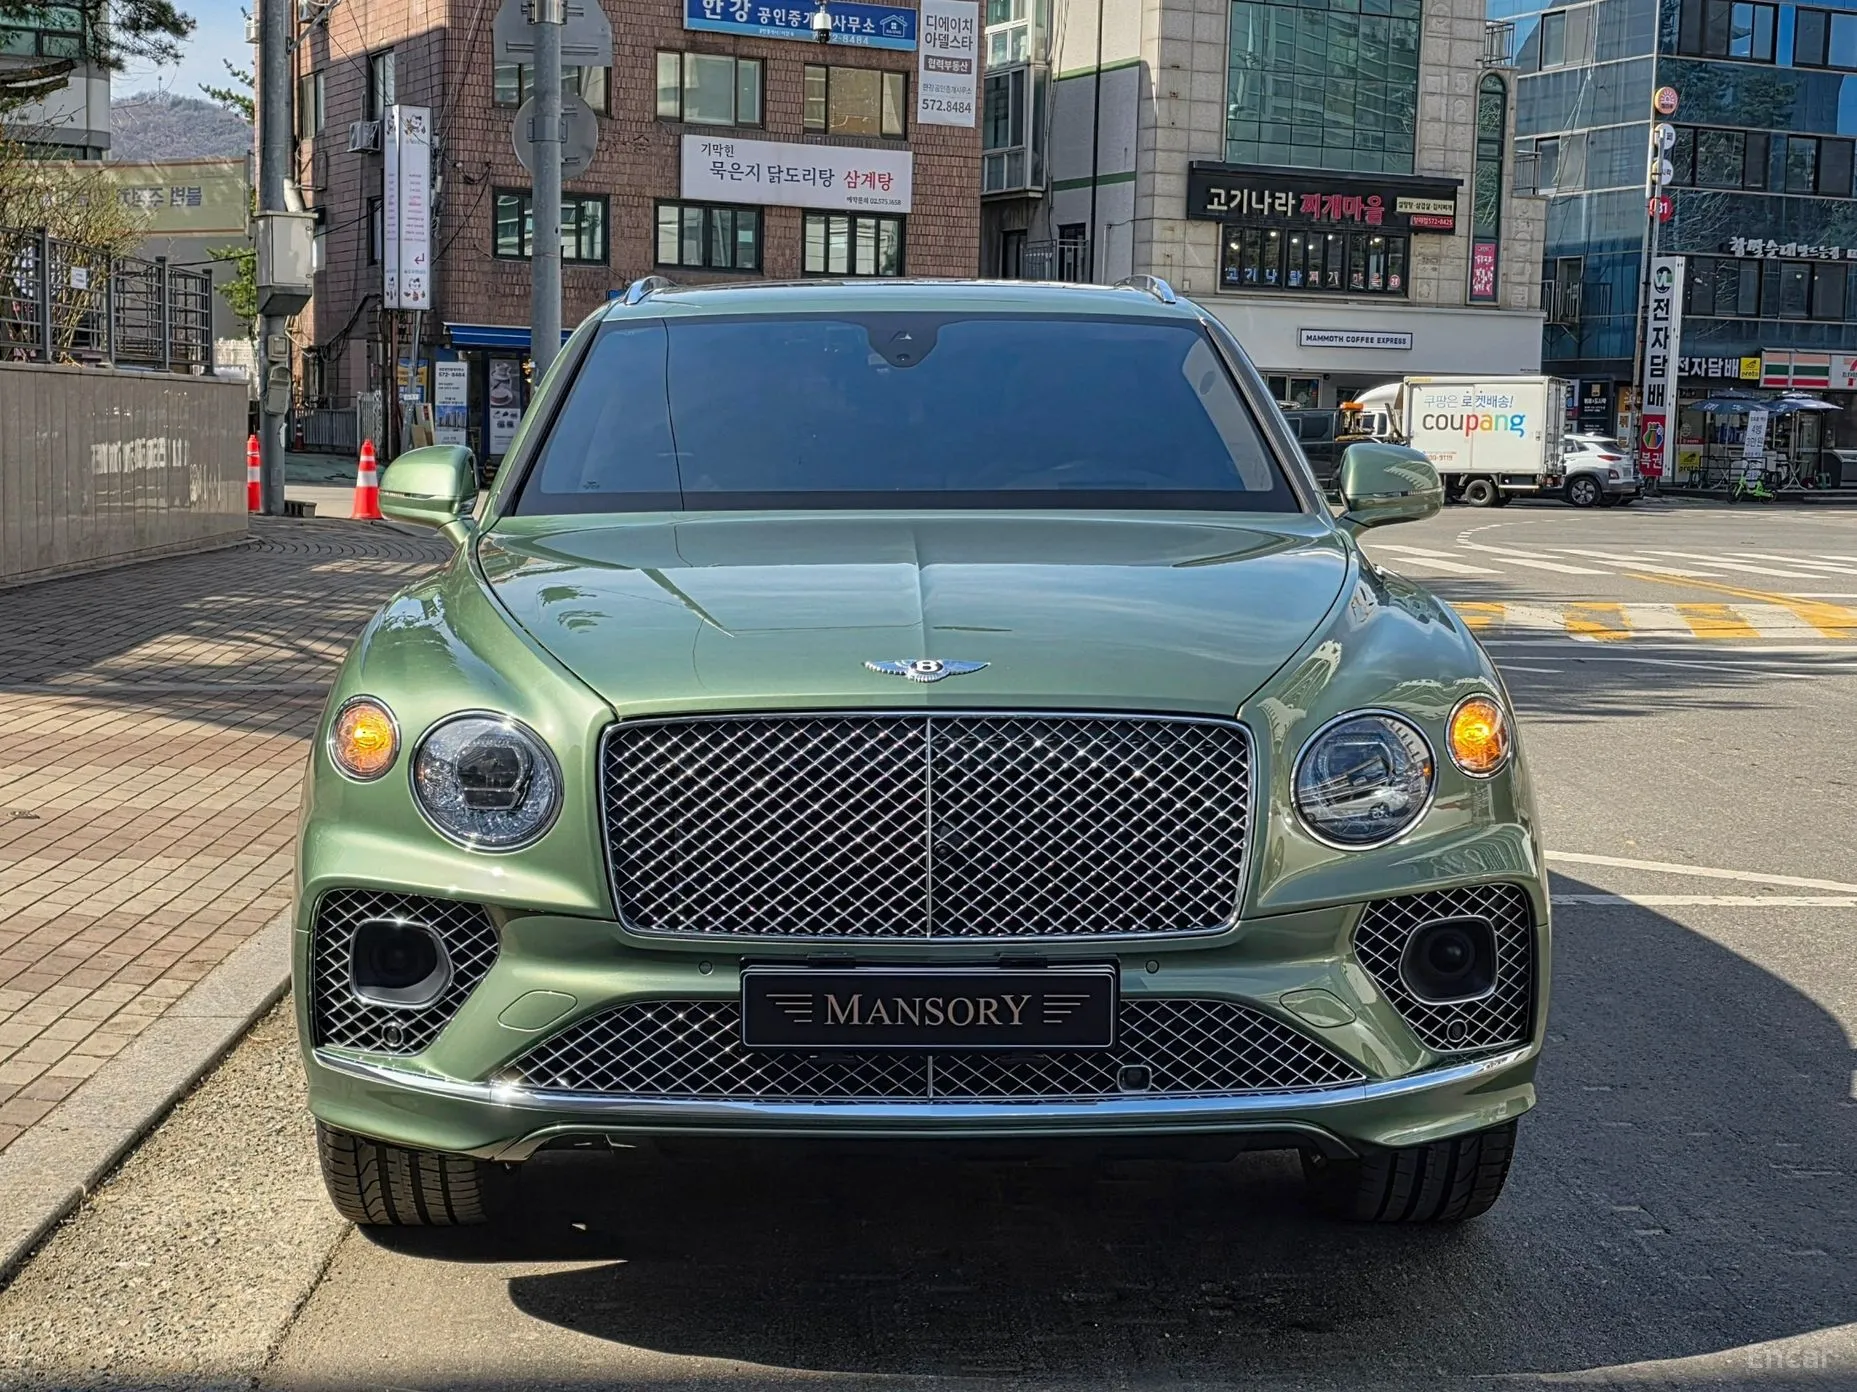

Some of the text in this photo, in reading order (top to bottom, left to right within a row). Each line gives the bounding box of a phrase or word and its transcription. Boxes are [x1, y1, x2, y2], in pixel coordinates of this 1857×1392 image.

[926, 15, 973, 34] 디에이치
[925, 32, 973, 51] 아델스타
[928, 58, 968, 72] 협력부동산
[922, 99, 972, 113] 572.8484
[701, 143, 734, 158] 기막힌
[710, 161, 894, 192] 묵은지 닭도리탕 삼계탕
[1207, 188, 1385, 225] 고기나라 찌개마을
[1306, 335, 1407, 345] MAMMOTH COFFEE EXPRESS
[1649, 298, 1669, 407] 전자담배
[1678, 357, 1739, 378] 전자담배
[1424, 395, 1458, 408] 쿠팡은
[1422, 414, 1526, 438] coupang
[1641, 451, 1663, 469] 복권
[823, 994, 1032, 1026] MANSORY
